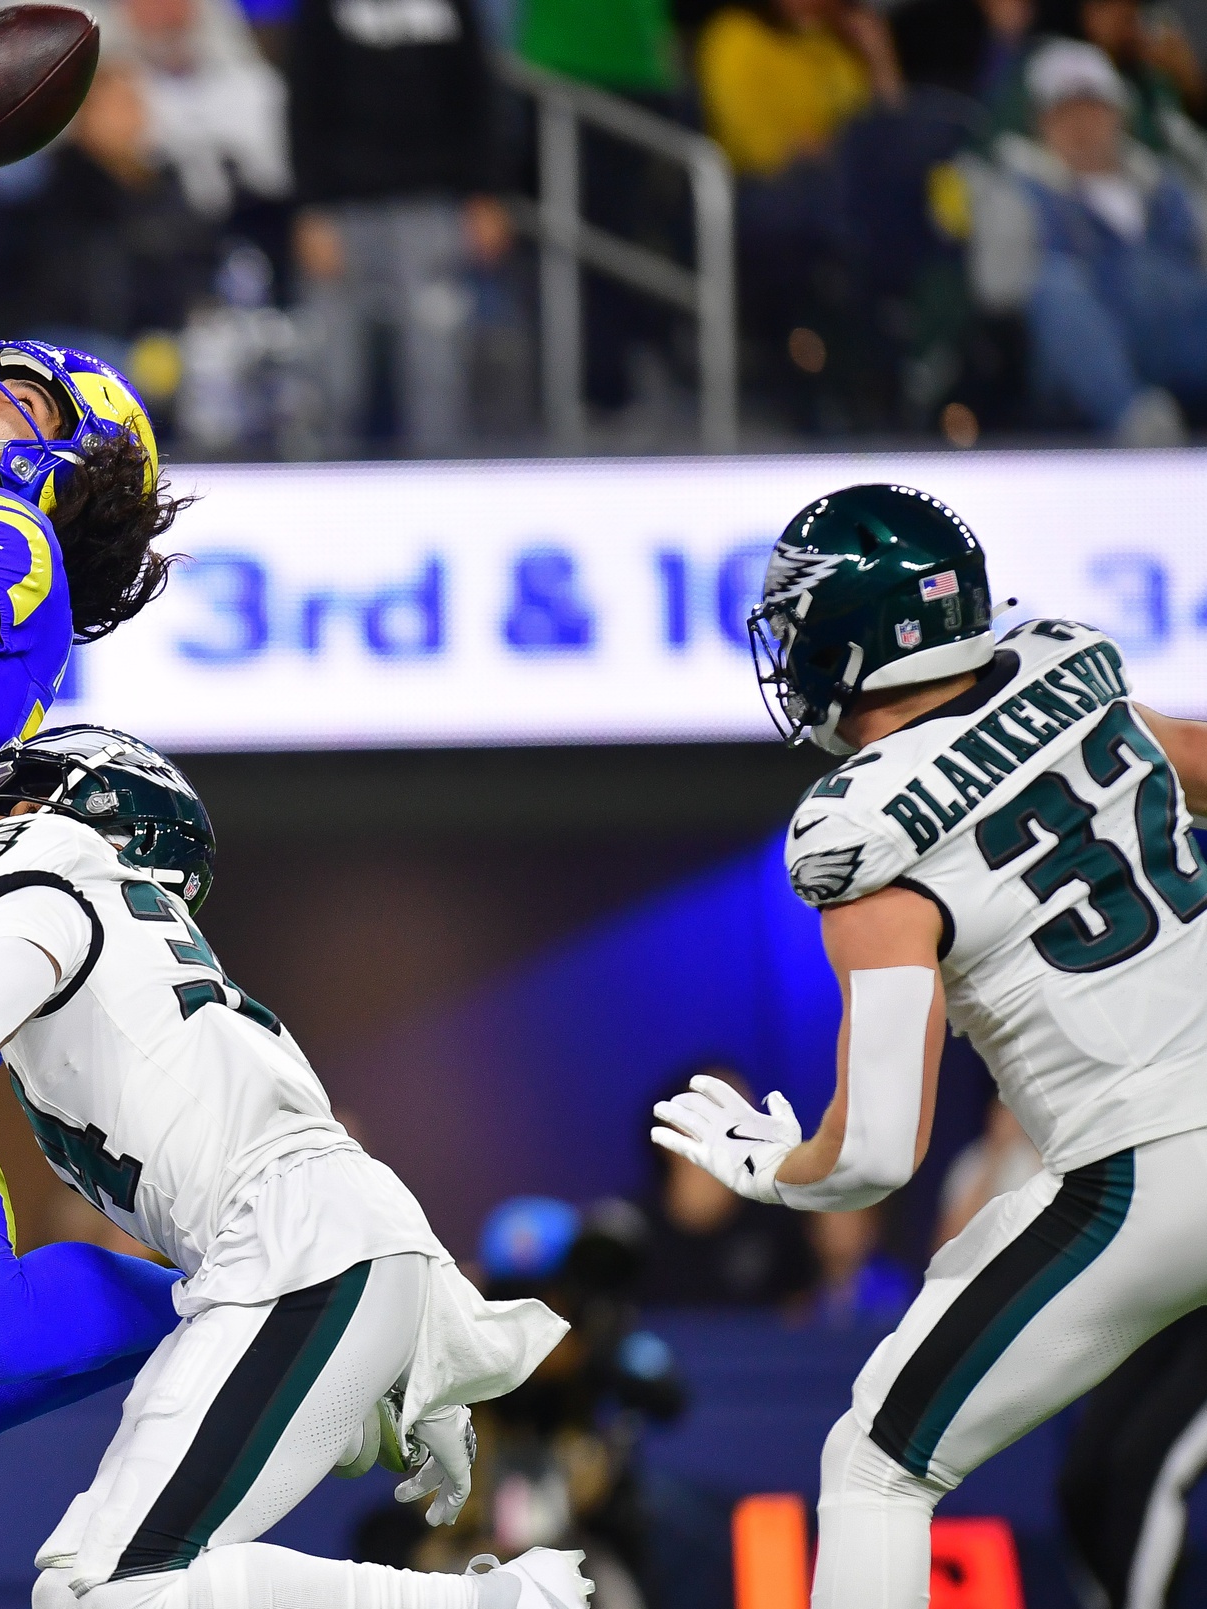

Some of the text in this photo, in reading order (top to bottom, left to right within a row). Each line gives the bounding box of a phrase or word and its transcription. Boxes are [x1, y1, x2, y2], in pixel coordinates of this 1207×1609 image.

[179, 548, 443, 658] 3rd
[502, 546, 591, 650] &
[883, 640, 1128, 857] BLANKENSHIP
[975, 700, 1207, 974] 32
